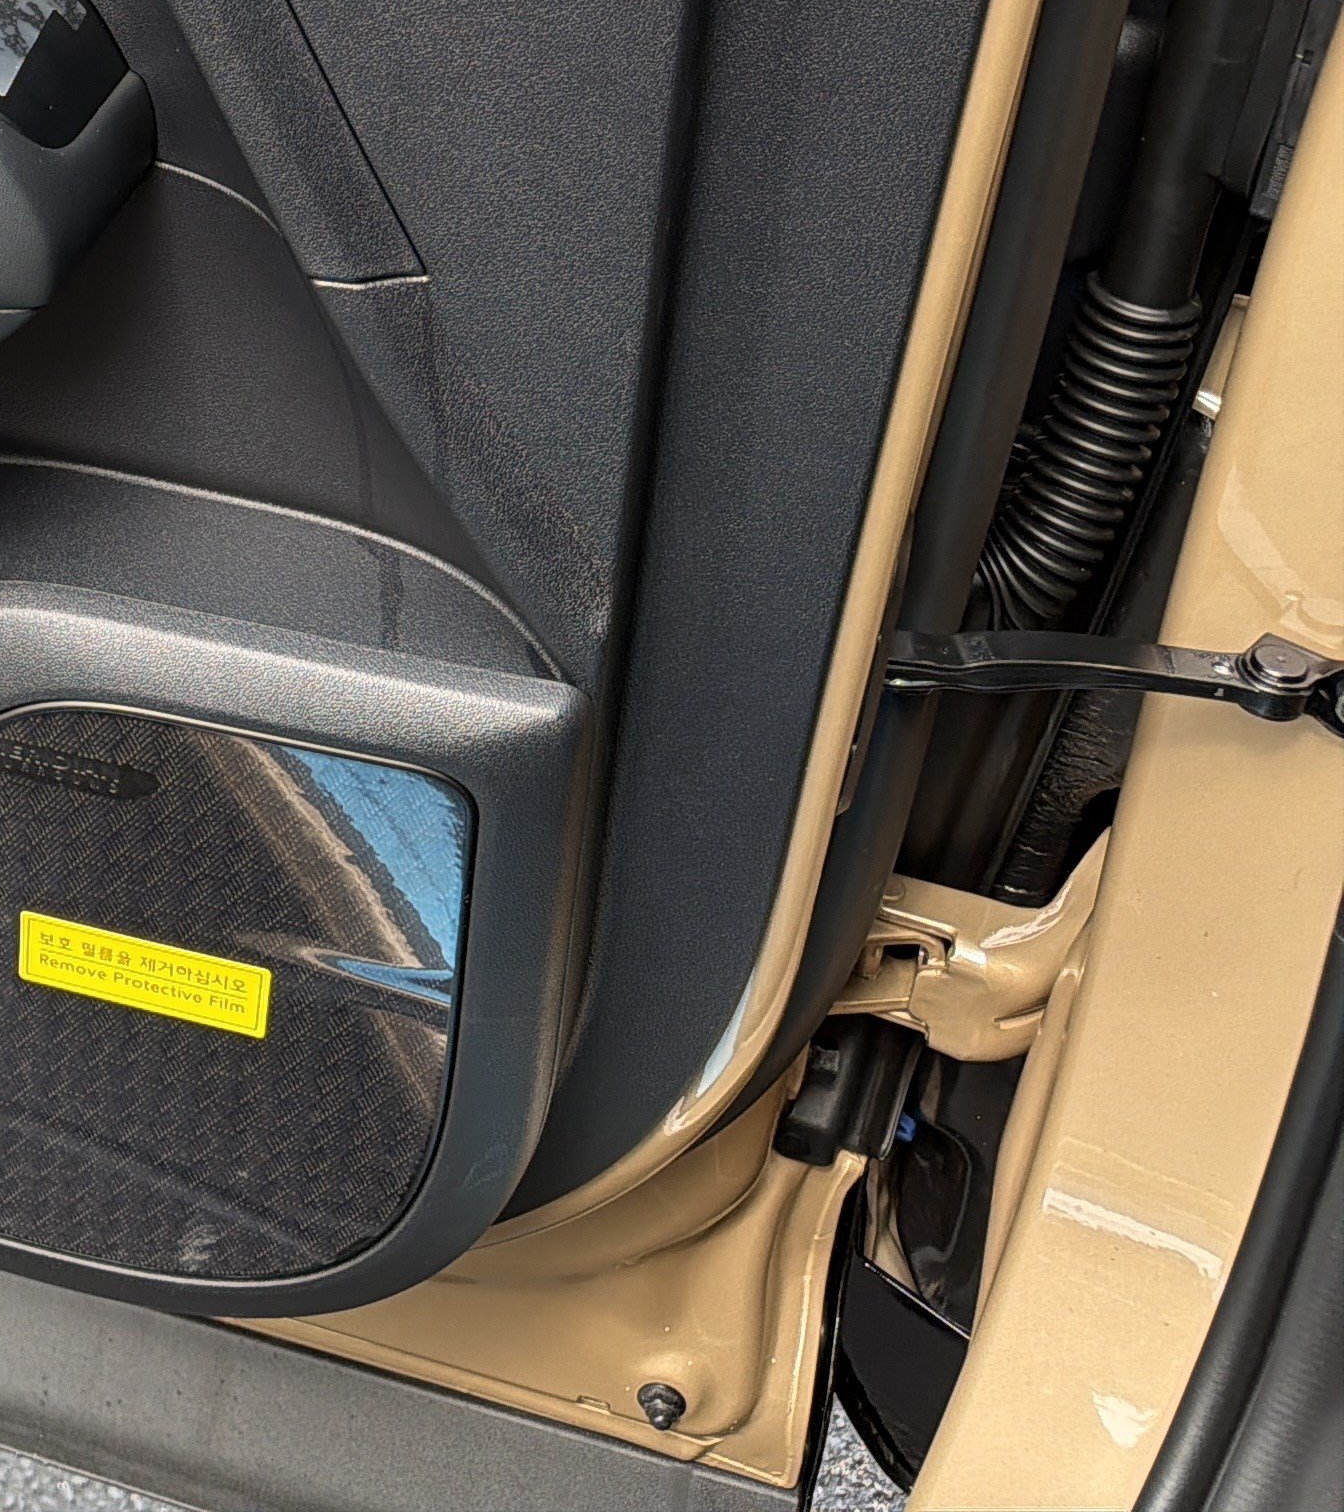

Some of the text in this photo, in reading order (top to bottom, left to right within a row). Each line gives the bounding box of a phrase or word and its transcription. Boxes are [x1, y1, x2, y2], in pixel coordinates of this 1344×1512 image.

[39, 952, 246, 1014] Remove Protective Film
